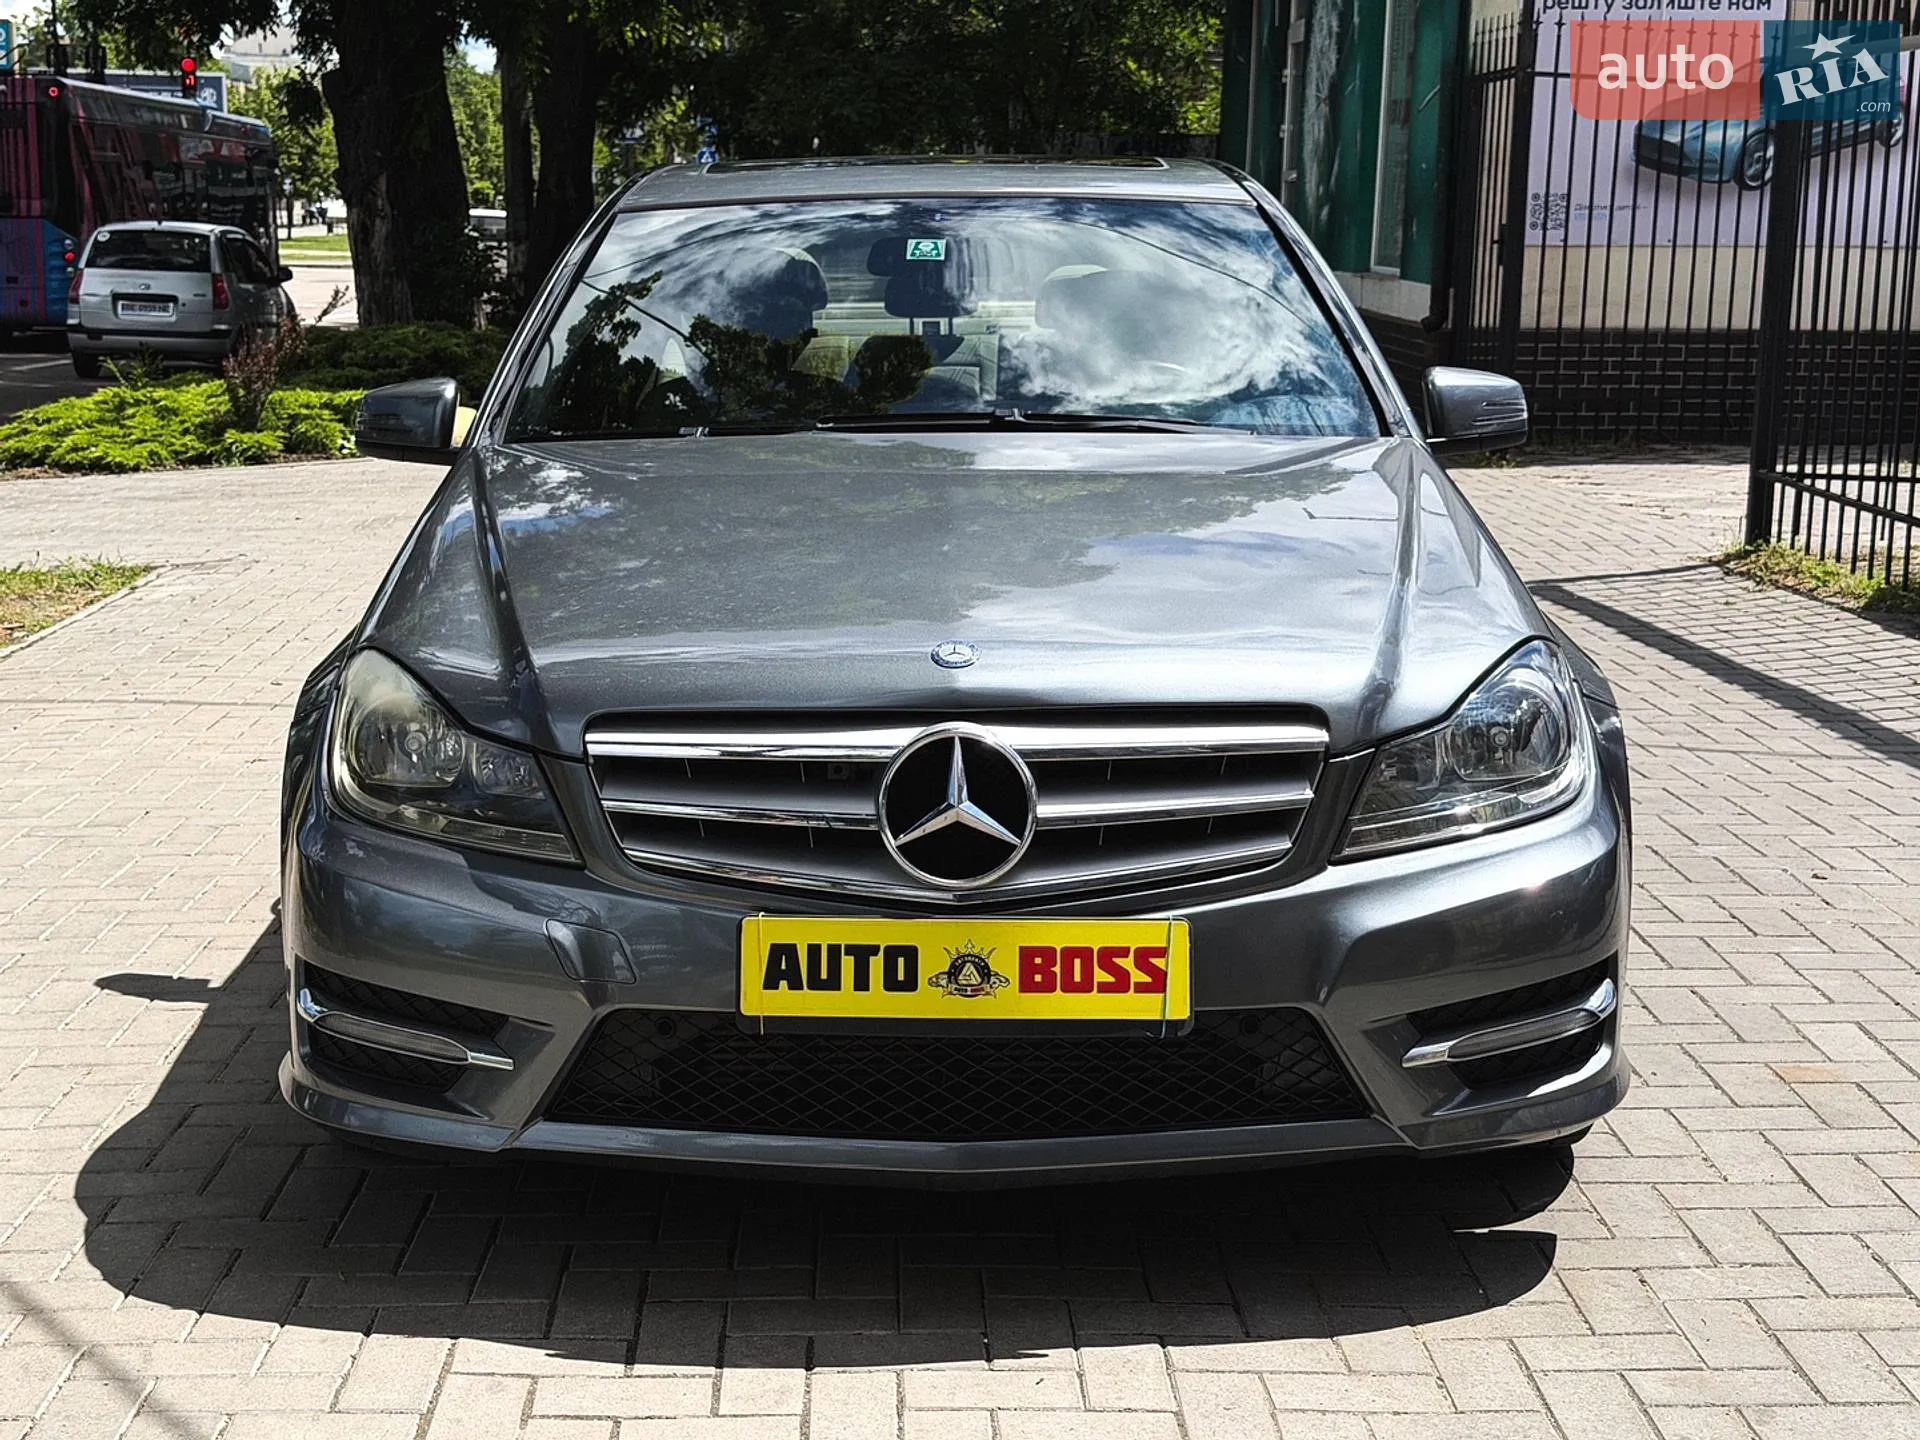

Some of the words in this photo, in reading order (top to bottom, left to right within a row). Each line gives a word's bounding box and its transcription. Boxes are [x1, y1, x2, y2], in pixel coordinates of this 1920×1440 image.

[1728, 0, 1771, 11] нам
[762, 943, 919, 992] AUTO
[1018, 945, 1168, 994] BOSS
